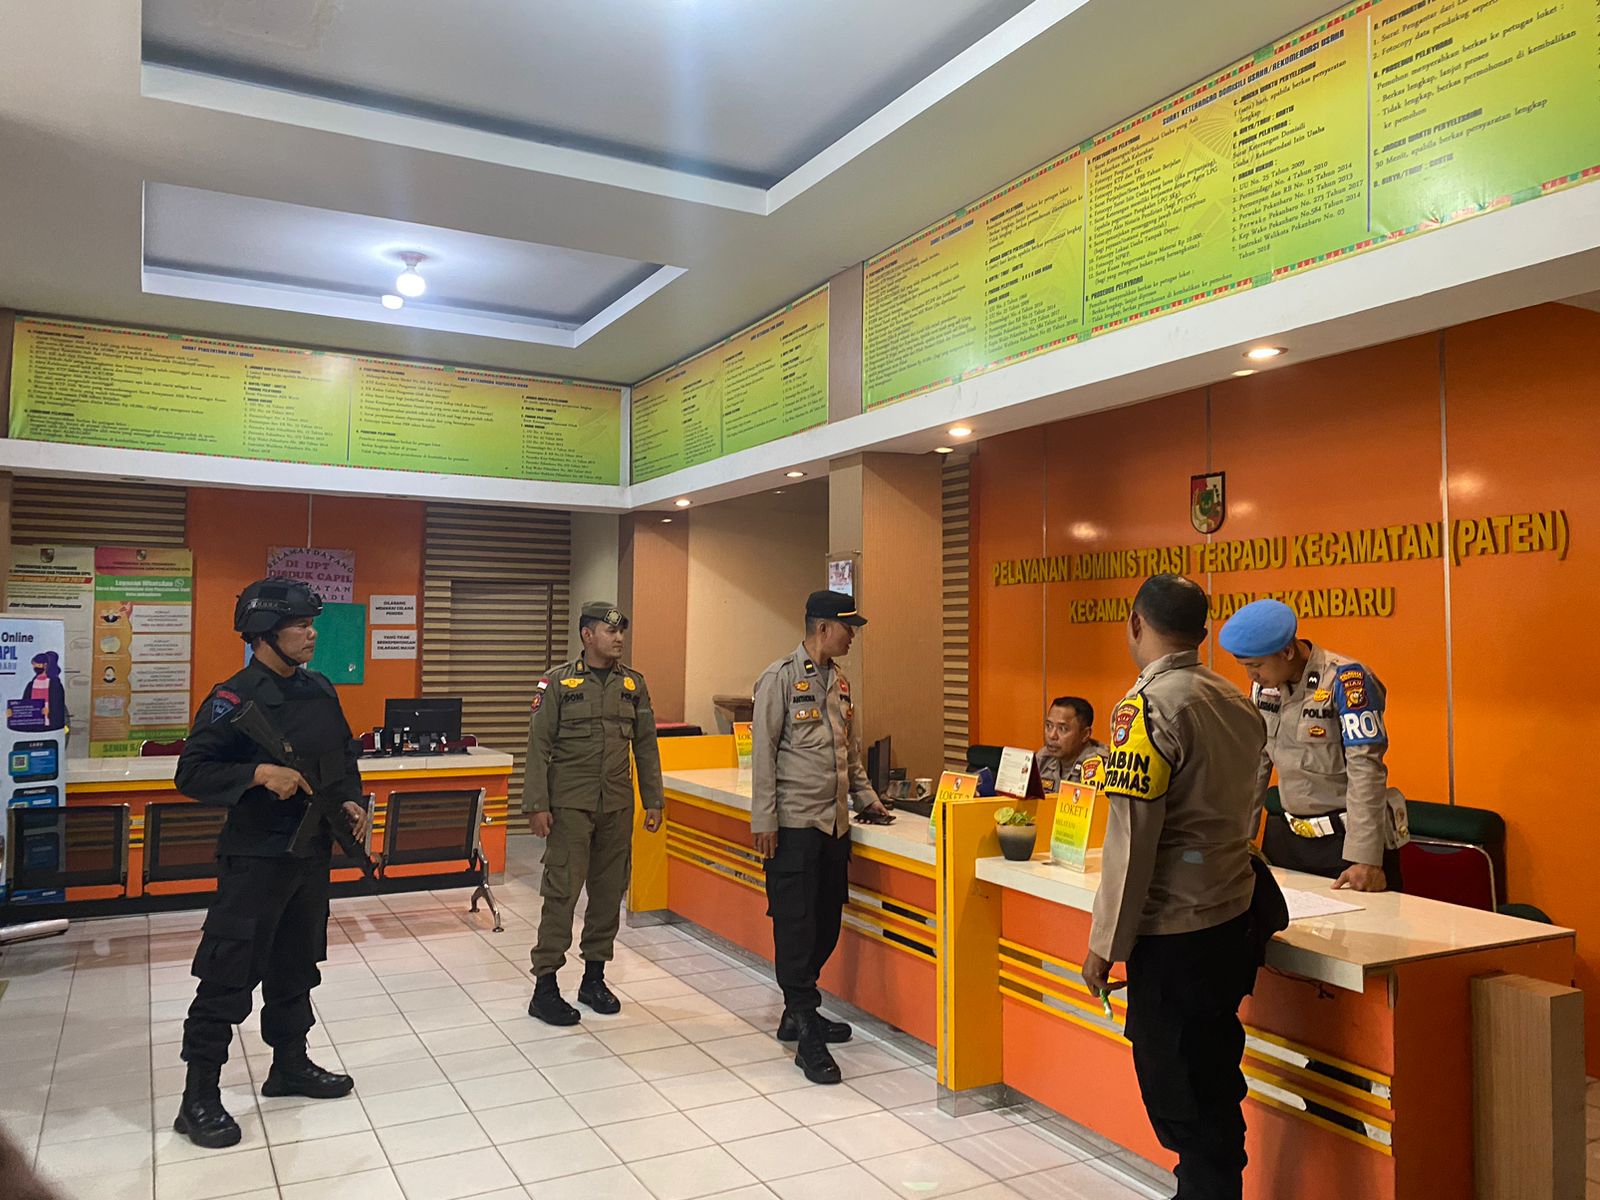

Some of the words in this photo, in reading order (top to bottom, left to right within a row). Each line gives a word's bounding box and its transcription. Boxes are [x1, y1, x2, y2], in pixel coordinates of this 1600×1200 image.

[1382, 28, 1399, 42] Surat
[1403, 12, 1437, 32] Pengantar
[1440, 0, 1455, 14] dari
[1377, 72, 1408, 90] Pemohon
[1412, 50, 1459, 75] menyerahkan
[1462, 38, 1487, 53] berkas
[1490, 32, 1500, 40] ke
[1503, 17, 1533, 37] petugas
[1536, 6, 1557, 20] loket
[1382, 37, 1412, 55] Fotocopy
[1415, 29, 1430, 40] data
[1270, 86, 1290, 100] apabila
[1292, 77, 1310, 89] berkas
[1312, 60, 1346, 81] persyaratan
[1382, 101, 1402, 116] Tidak
[1437, 79, 1461, 93] berkas
[1464, 57, 1513, 83] permohonan
[1516, 49, 1524, 60] di
[1528, 30, 1576, 55] kembalikan
[1382, 88, 1404, 102] Berkas
[1440, 62, 1462, 77] lanjut
[1465, 52, 1489, 68] proses
[1163, 111, 1180, 125] SURAT
[1240, 110, 1261, 123] lengkap
[1384, 120, 1392, 129] ke
[1395, 107, 1426, 126] pemohon
[1232, 148, 1247, 159] Surat
[1248, 135, 1279, 152] Keterangan
[1281, 122, 1305, 138] Domisili
[1255, 139, 1291, 159] Rekomendasi
[1307, 126, 1325, 137] Usaha
[1375, 159, 1384, 169] 30
[1411, 141, 1436, 155] apabila
[1439, 131, 1463, 144] berkas
[1466, 113, 1511, 136] persyaratan
[1514, 99, 1547, 116] lengkap
[1239, 182, 1272, 200] Permendagri
[1293, 168, 1311, 178] Tahun
[1313, 160, 1328, 171] 2010
[1271, 190, 1281, 198] dan
[1316, 169, 1335, 180] Tahun
[1337, 161, 1352, 172] 2014
[1272, 166, 1289, 177] Tahun
[1291, 159, 1305, 169] 2009
[1263, 196, 1292, 211] Pekanbaru
[1317, 180, 1336, 191] Tahun
[1269, 204, 1298, 219] Pekanbaru
[1326, 187, 1346, 198] Tahun
[1269, 215, 1298, 229] Pekanbaru
[1324, 199, 1343, 209] Tahun
[1345, 191, 1360, 202] 2014
[1291, 217, 1321, 231] Pekanbaru
[992, 556, 1069, 586] PELAYANAN
[1071, 545, 1189, 581] ADMINISTRASI
[1195, 537, 1286, 573] TERPADU
[1291, 522, 1444, 567] KECAMATAN
[1450, 510, 1568, 566] (PATEN)
[286, 560, 299, 568] DI
[306, 561, 330, 570] UPT
[317, 572, 353, 583] CAPIL
[2, 632, 34, 642] Online
[1060, 802, 1084, 818] LOKET
